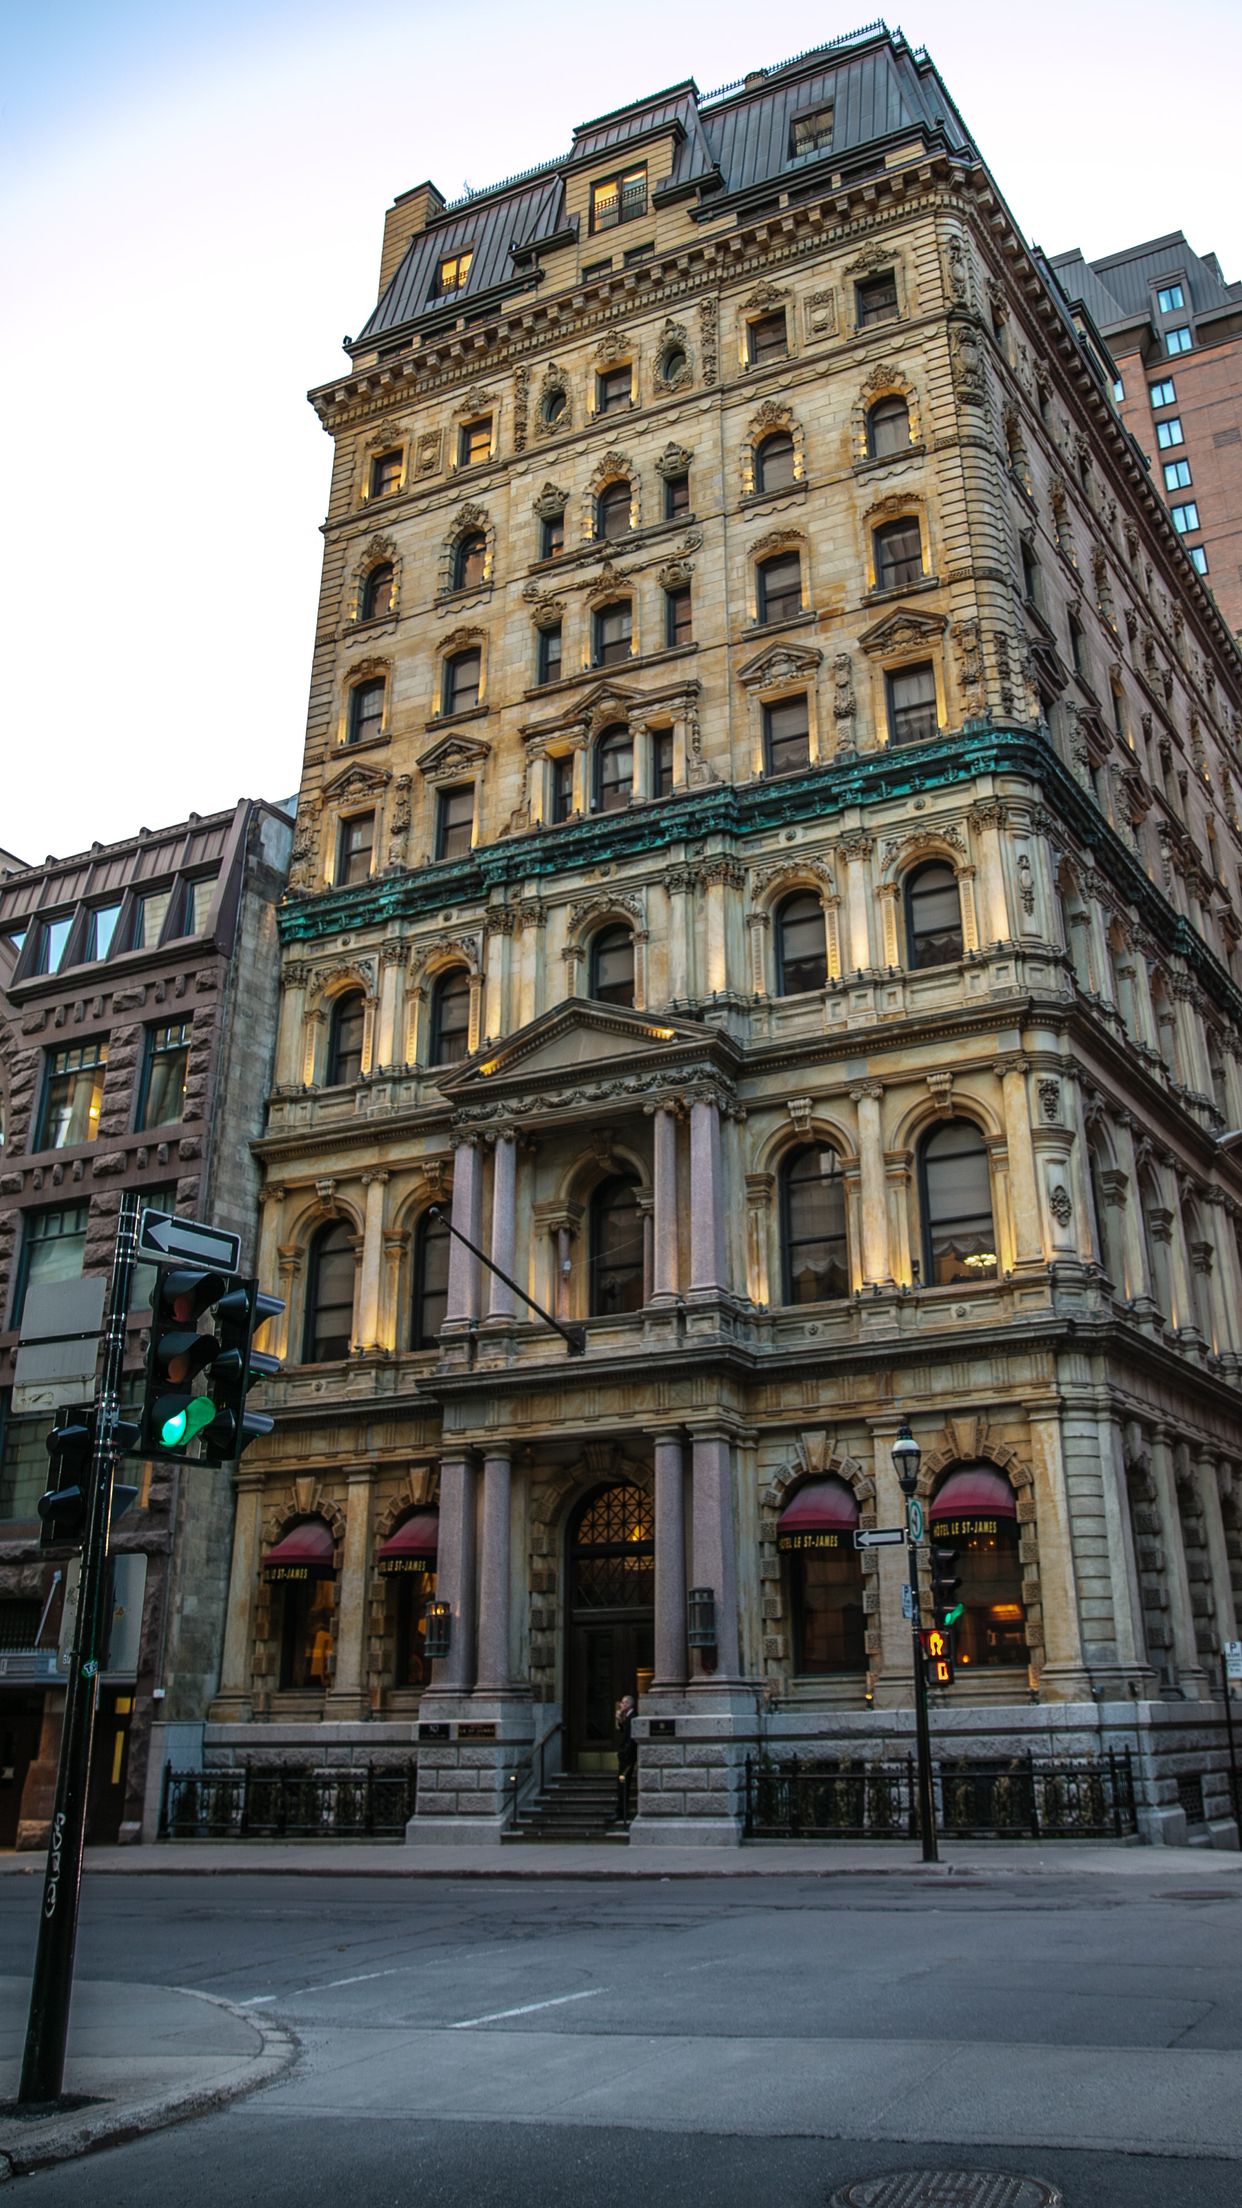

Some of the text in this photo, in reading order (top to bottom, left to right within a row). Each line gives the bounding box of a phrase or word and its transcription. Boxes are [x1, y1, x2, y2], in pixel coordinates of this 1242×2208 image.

[951, 1522, 959, 1535] LE
[962, 1521, 997, 1533] ST-JAMES
[794, 1536, 801, 1548] LE
[804, 1535, 838, 1548] ST-JAMES
[395, 1560, 426, 1571] ST-JAMES
[277, 1568, 308, 1579] ST-JAMES
[1230, 1642, 1237, 1653] P
